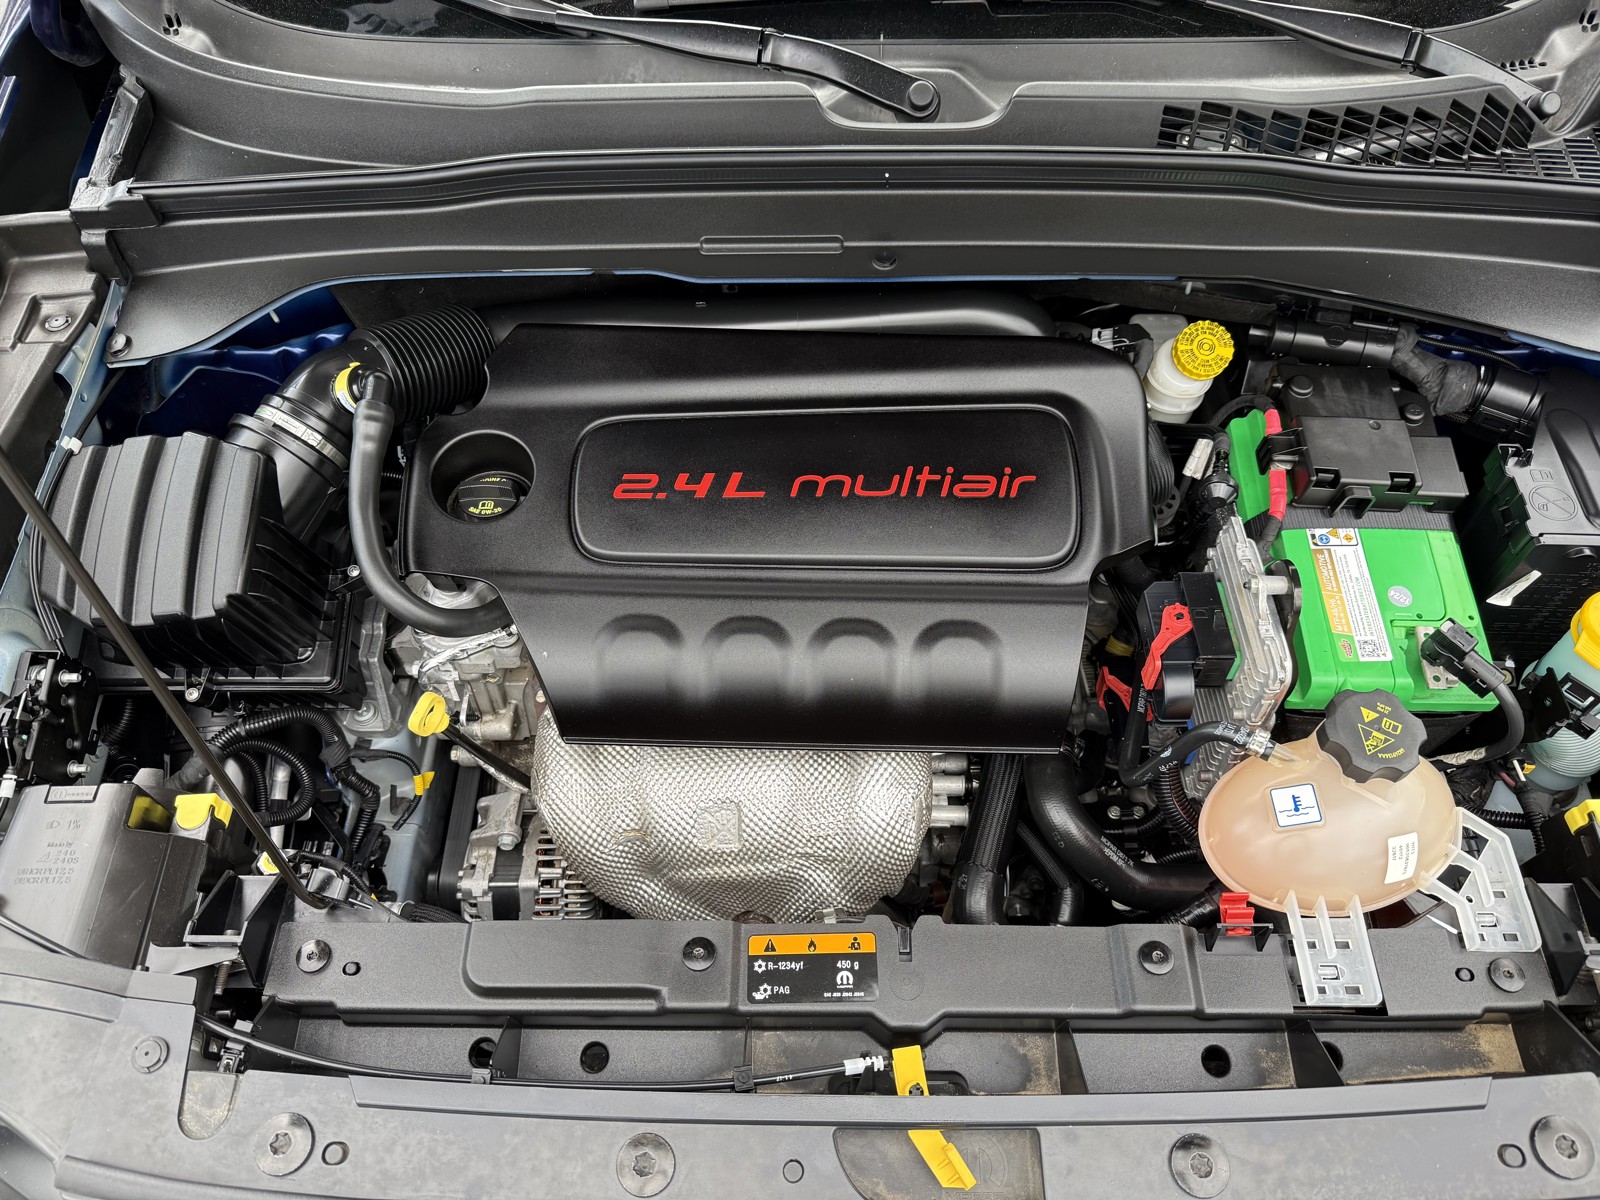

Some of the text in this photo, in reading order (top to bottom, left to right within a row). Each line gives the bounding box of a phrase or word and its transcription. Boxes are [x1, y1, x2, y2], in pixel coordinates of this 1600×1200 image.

[790, 465, 1037, 499] multiair
[1316, 554, 1332, 591] AUTOMOTIVE
[768, 961, 804, 971] R-1234yf
[836, 960, 859, 970] 450 g
[774, 986, 790, 994] PAG
